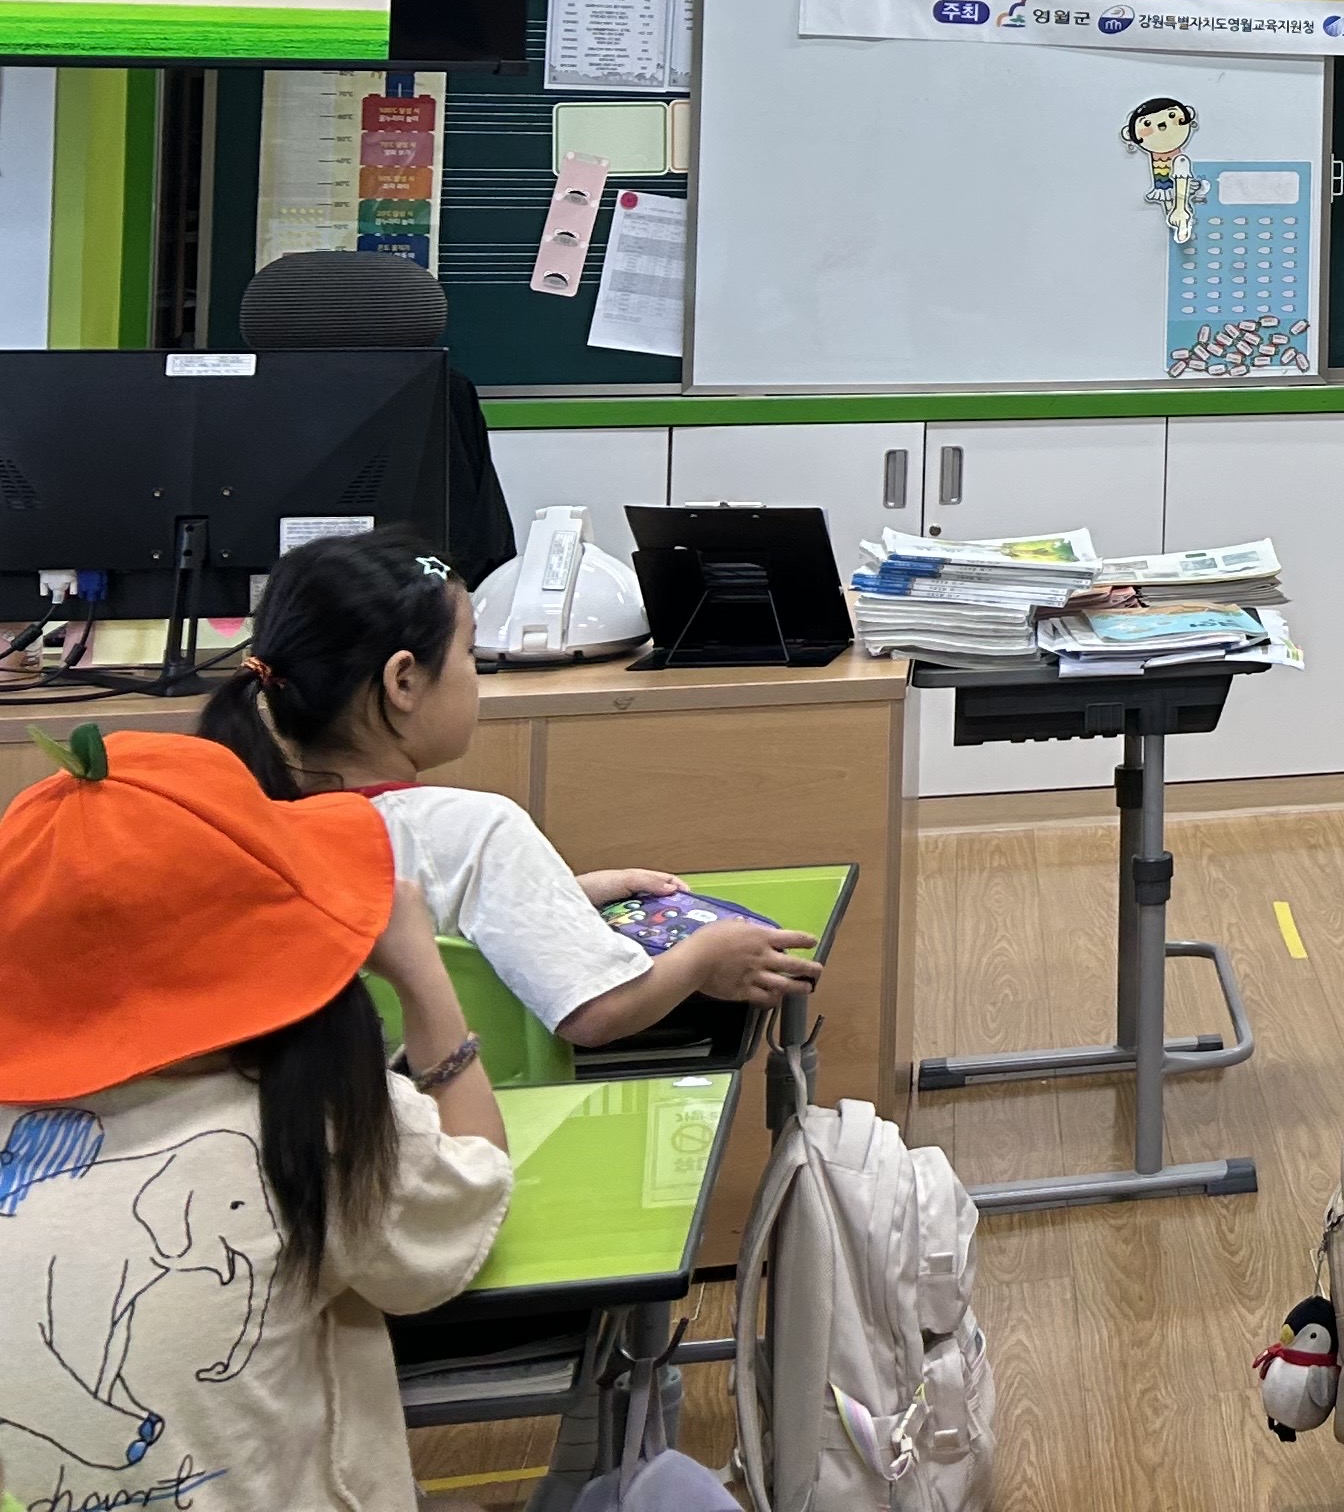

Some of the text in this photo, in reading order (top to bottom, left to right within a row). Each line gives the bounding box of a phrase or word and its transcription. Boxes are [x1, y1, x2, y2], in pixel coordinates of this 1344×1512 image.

[941, 0, 980, 23] 주최
[1033, 8, 1091, 27] 영월군
[1138, 12, 1316, 36] 강원특별자치도영월교육지원청
